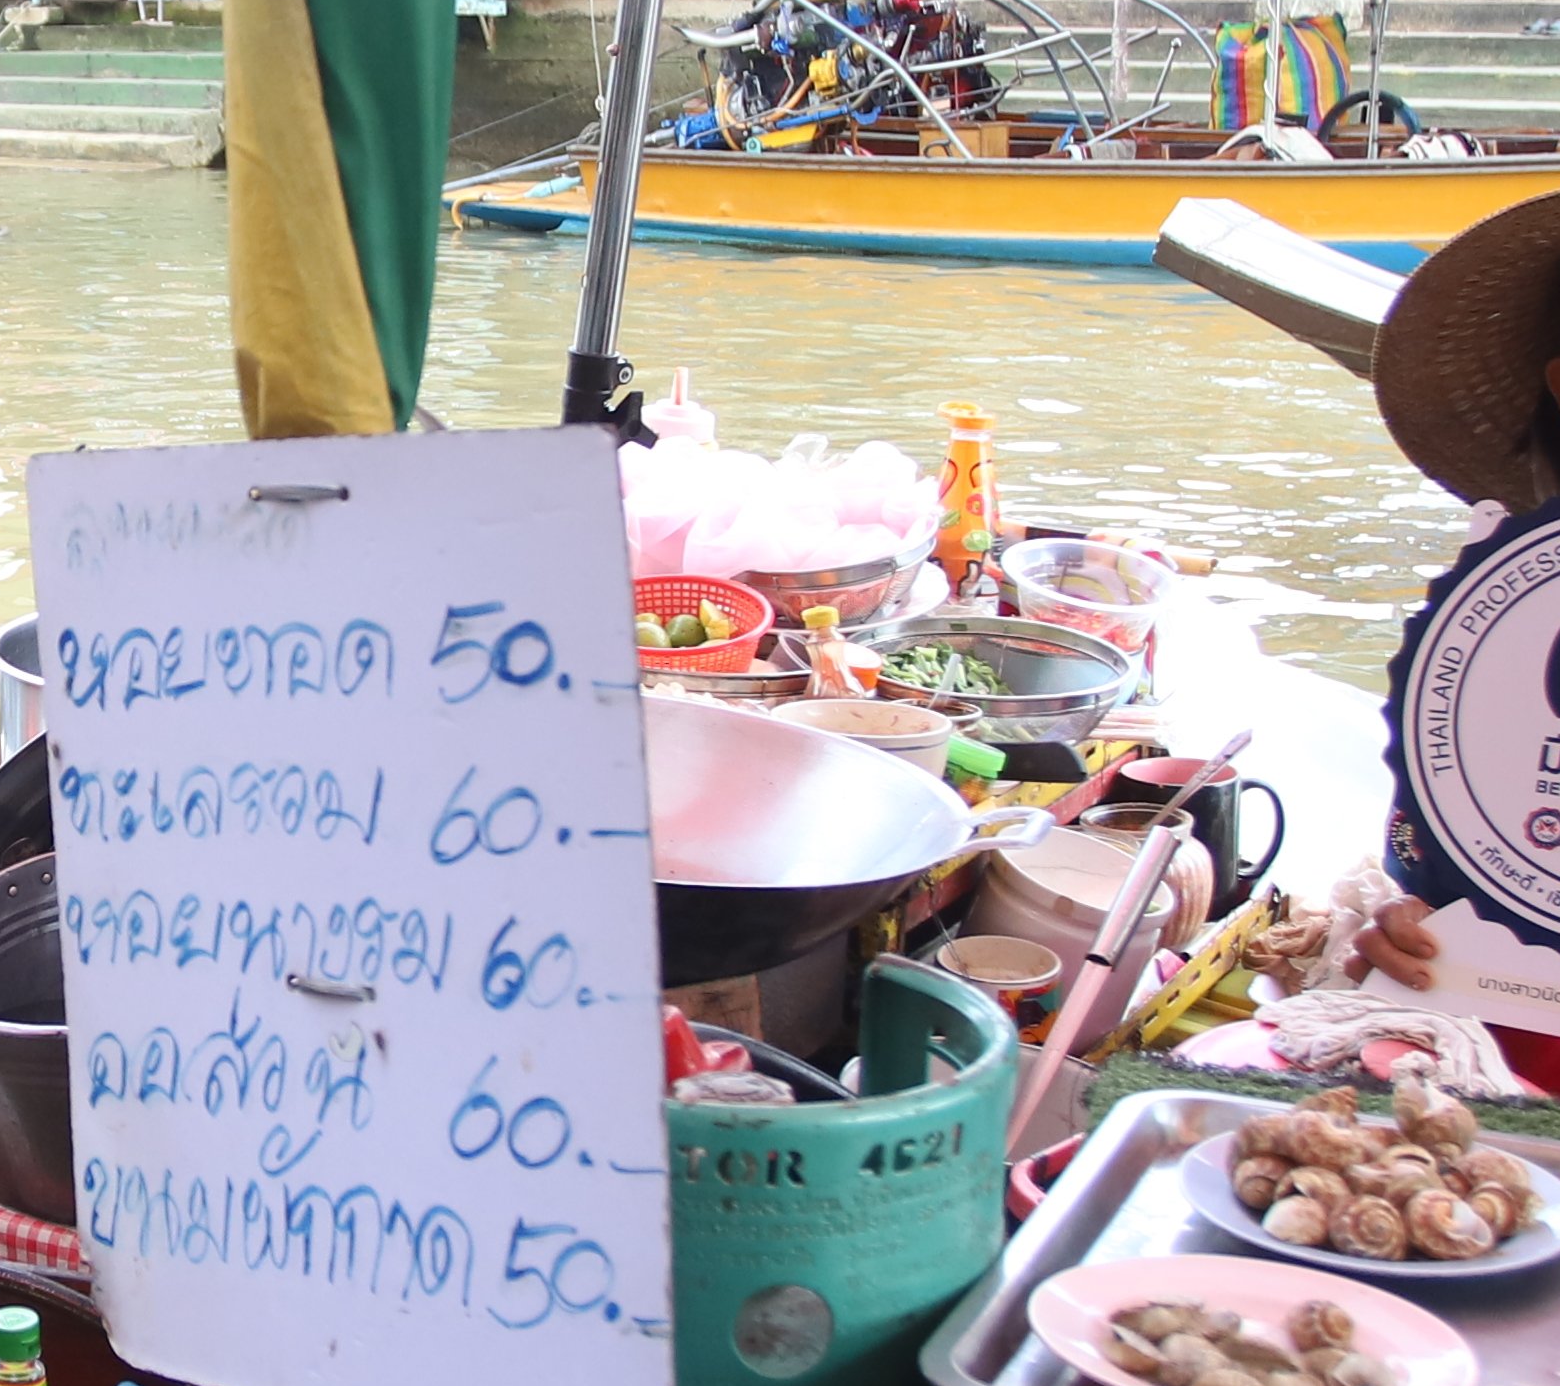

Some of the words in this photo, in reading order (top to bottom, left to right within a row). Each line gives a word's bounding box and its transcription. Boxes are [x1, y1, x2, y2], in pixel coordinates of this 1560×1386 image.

[58, 618, 394, 711] หอยทอด
[1426, 643, 1468, 777] THAILAND
[58, 761, 386, 846] ทะเลรวม
[66, 889, 453, 993] หอยนางรม
[83, 1124, 475, 1308] ขนมผักกาด
